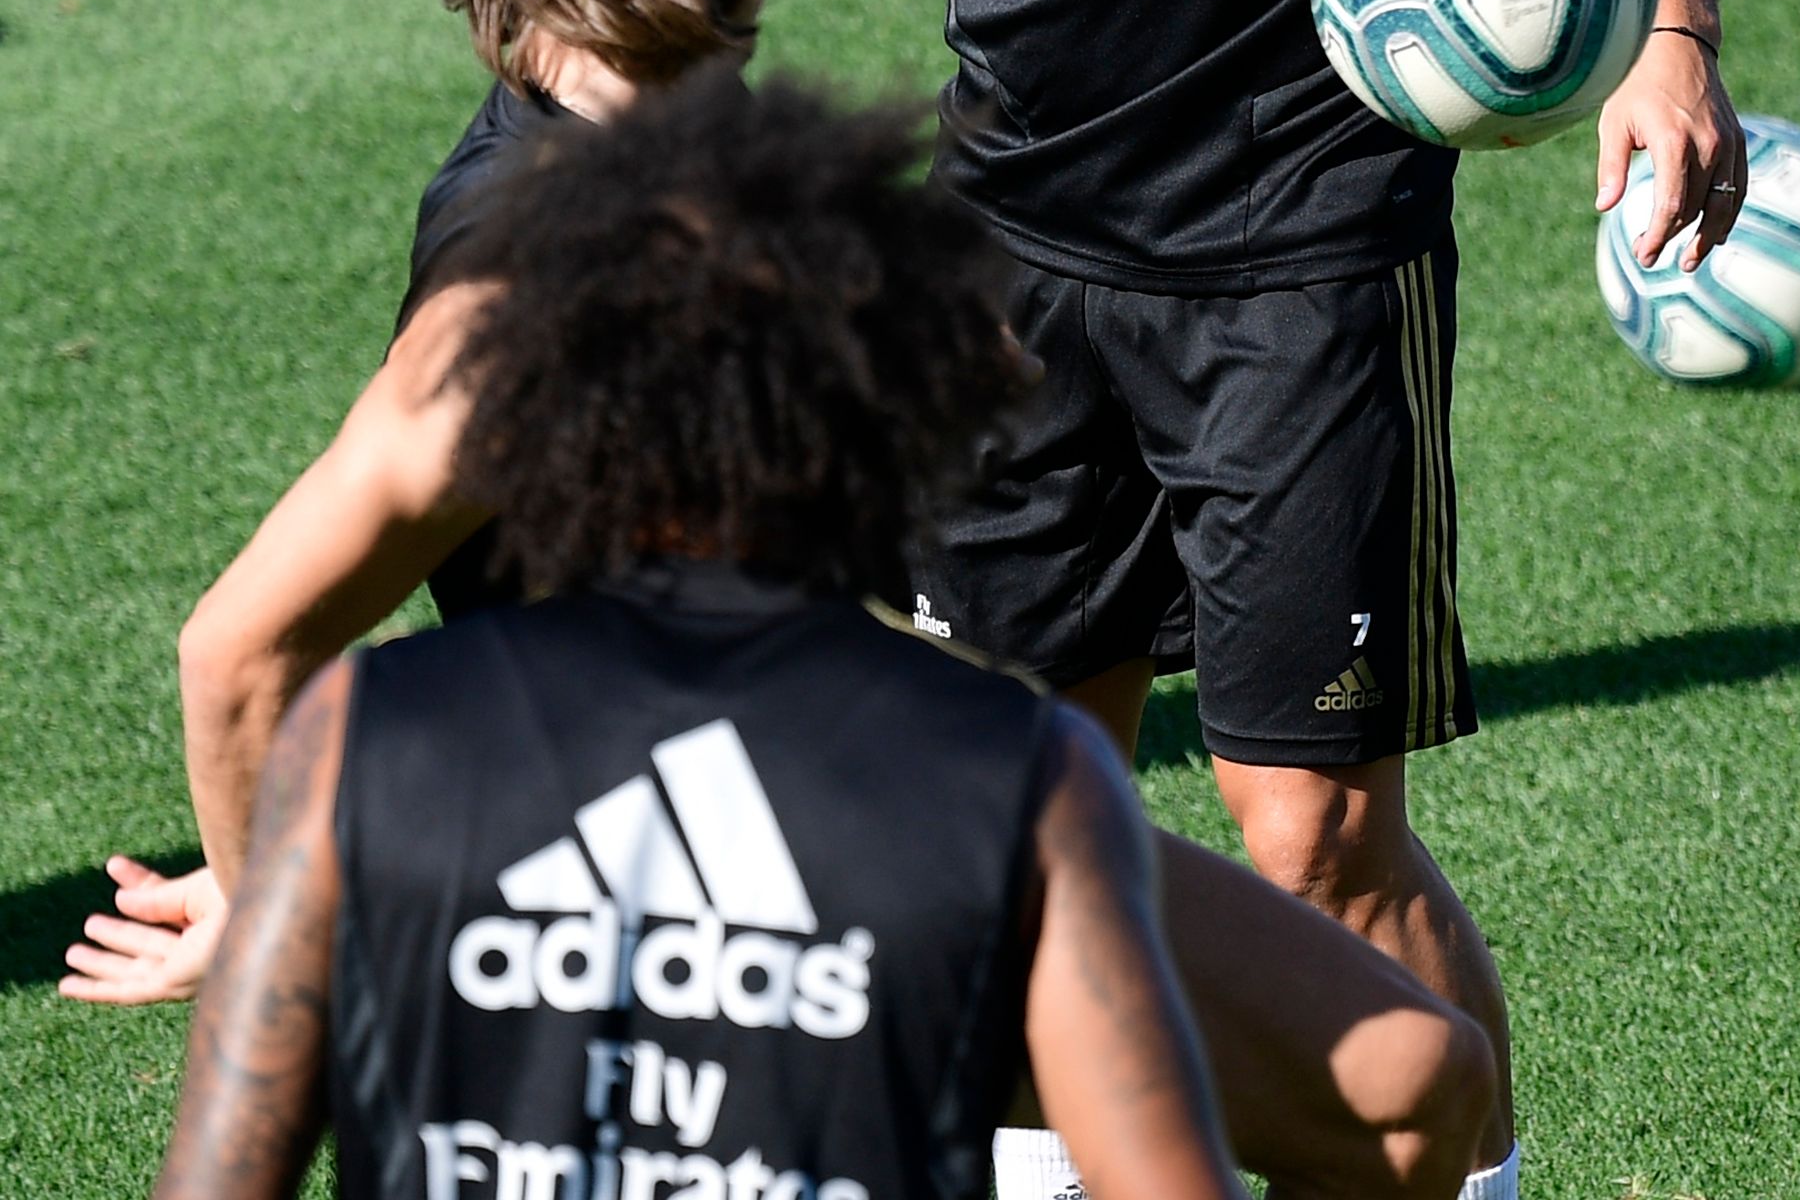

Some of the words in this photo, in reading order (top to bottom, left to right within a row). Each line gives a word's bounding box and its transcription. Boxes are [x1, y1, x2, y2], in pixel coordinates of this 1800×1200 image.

[1351, 612, 1371, 647] 7
[1314, 690, 1384, 711] adidas
[448, 898, 874, 1040] adidas
[585, 1039, 727, 1148] Fly
[418, 1118, 870, 1200] Emirat
